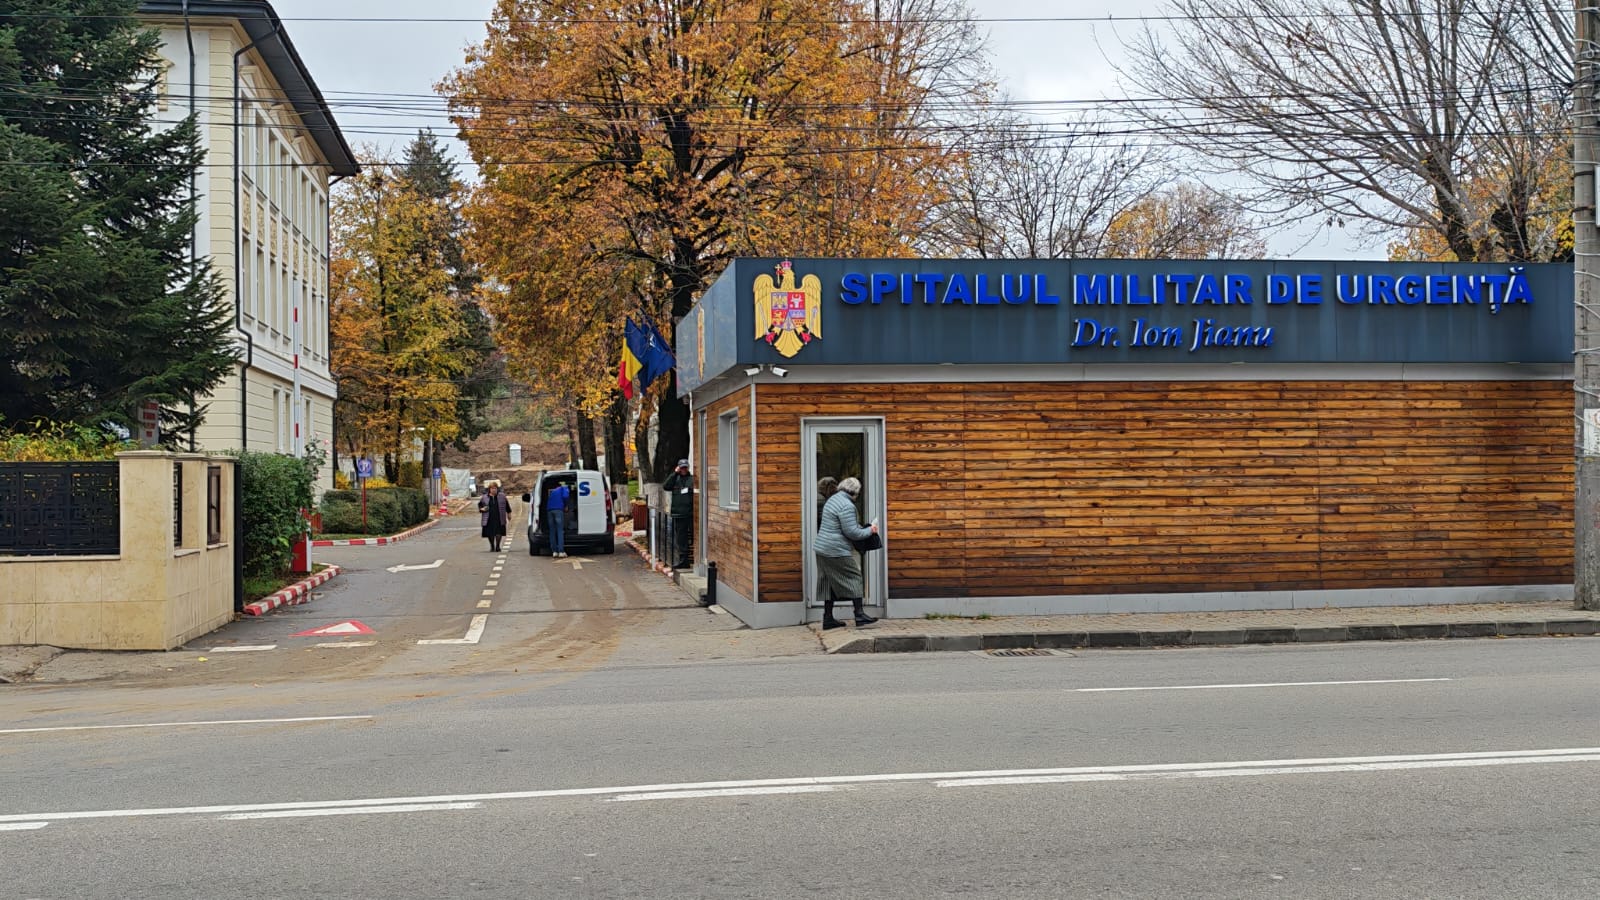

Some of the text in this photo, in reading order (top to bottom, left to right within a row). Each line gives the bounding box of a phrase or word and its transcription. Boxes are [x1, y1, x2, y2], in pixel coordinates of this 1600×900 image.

[839, 271, 1061, 306] SPITALUL
[1073, 272, 1254, 306] MILITAR
[1266, 273, 1324, 306] DE
[1070, 317, 1275, 352] Dr. Ion Jianu
